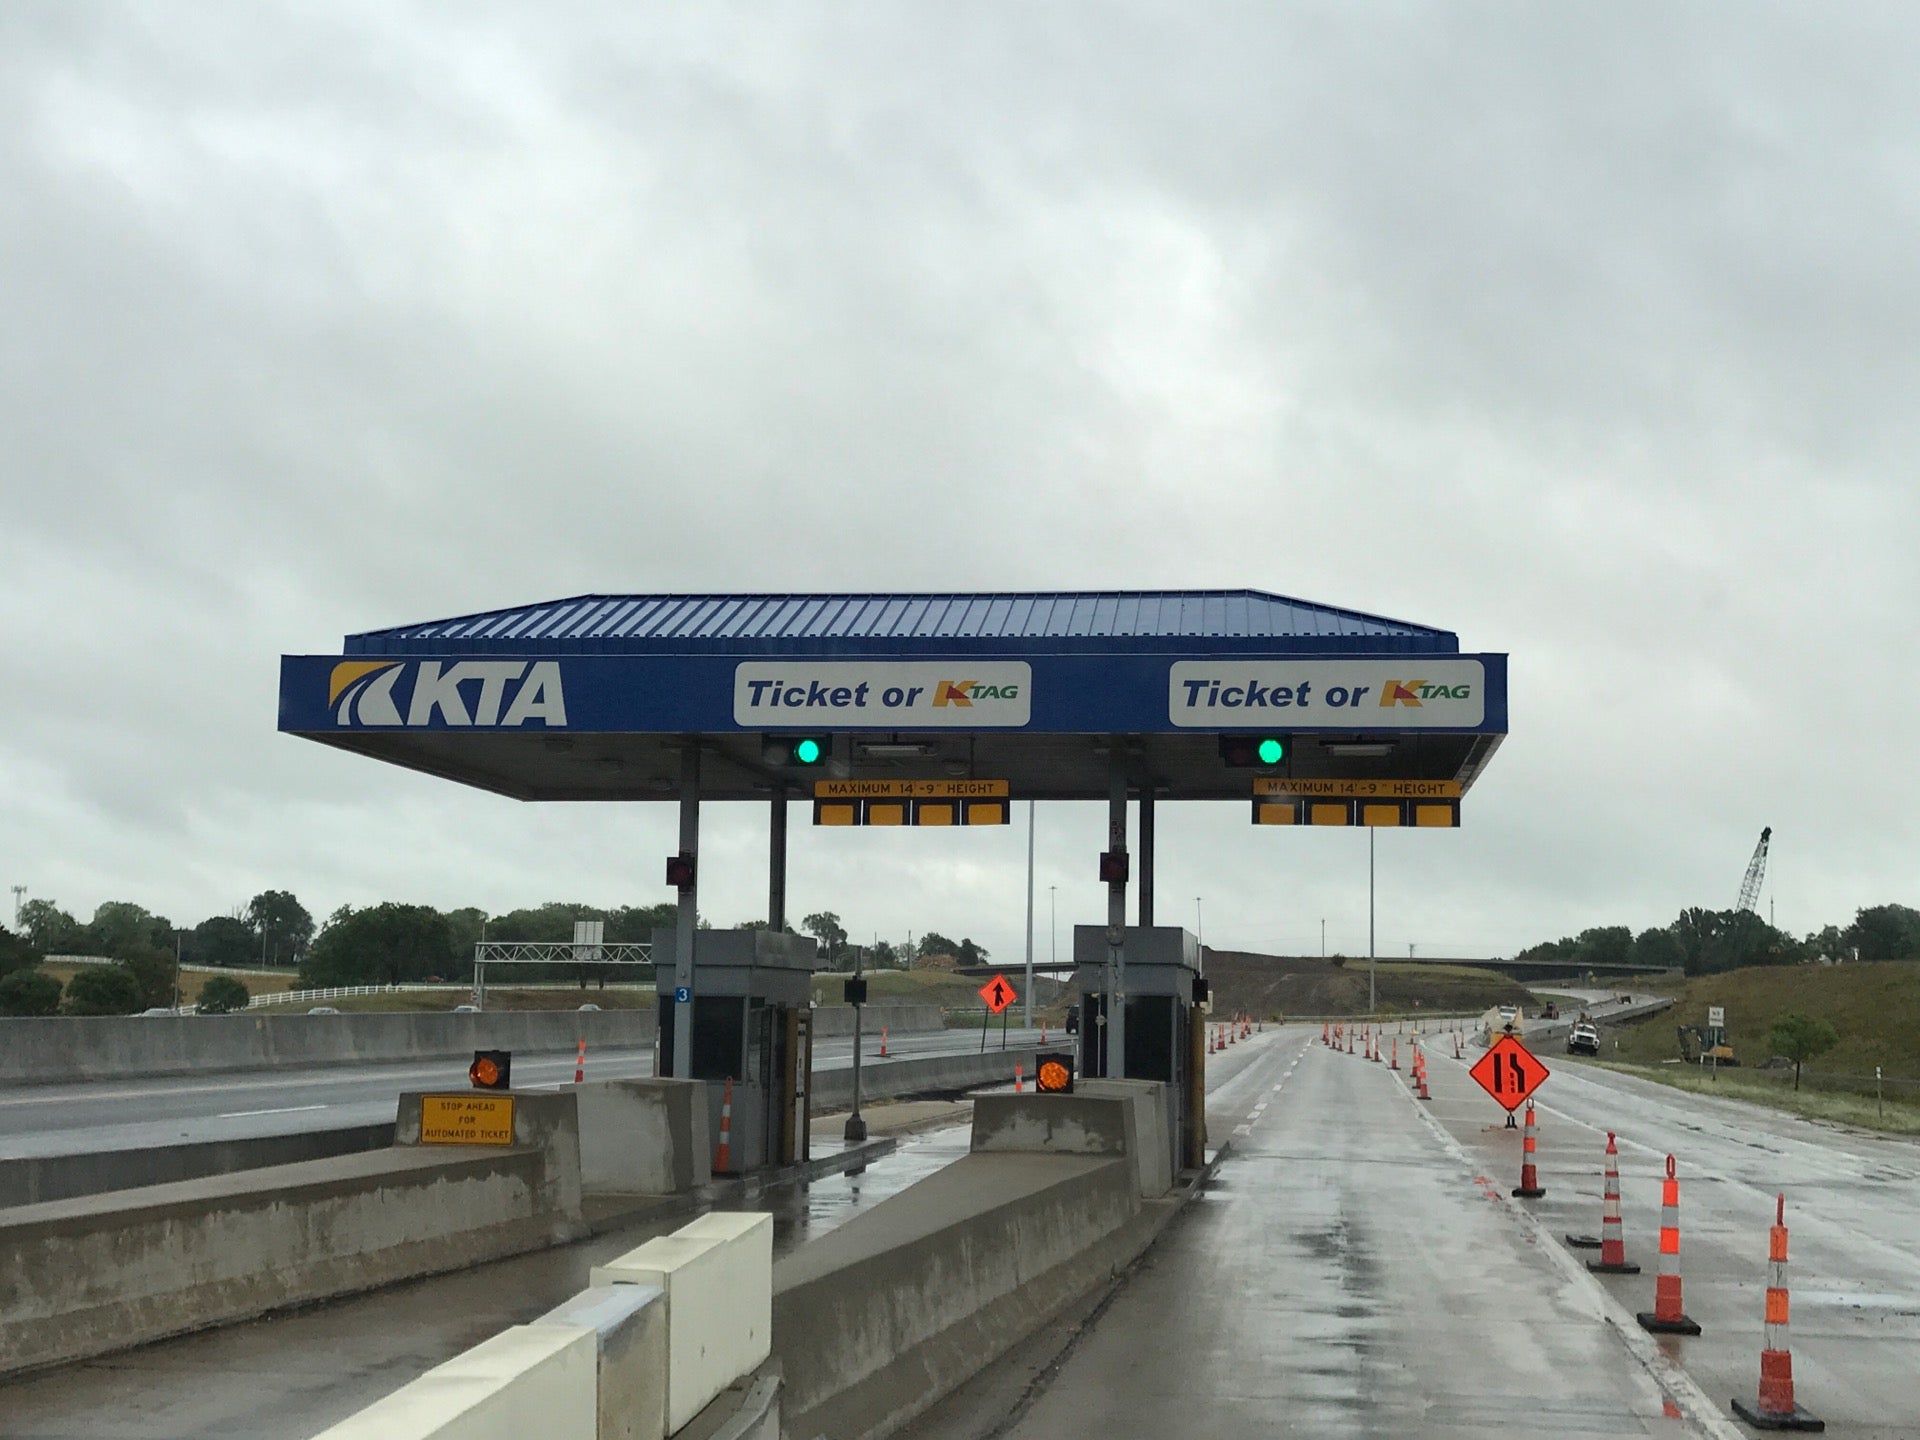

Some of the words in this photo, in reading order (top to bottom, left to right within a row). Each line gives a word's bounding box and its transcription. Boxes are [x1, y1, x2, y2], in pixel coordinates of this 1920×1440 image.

[407, 661, 568, 726] KTA
[747, 680, 869, 707] Ticket
[882, 686, 923, 707] or
[1183, 680, 1310, 707] Ticket
[1325, 686, 1369, 707] or
[828, 783, 890, 794] MAXIMUM
[947, 783, 994, 794] HEIGHT
[1267, 782, 1333, 793] MAXIMUM
[1393, 783, 1445, 794] HEIGHT
[678, 988, 688, 1002] 3
[441, 1102, 463, 1111] STOP
[466, 1103, 495, 1111] AHEAD
[458, 1116, 476, 1124] FOR
[425, 1129, 476, 1138] AUTOMATED
[480, 1130, 509, 1139] TICKET
